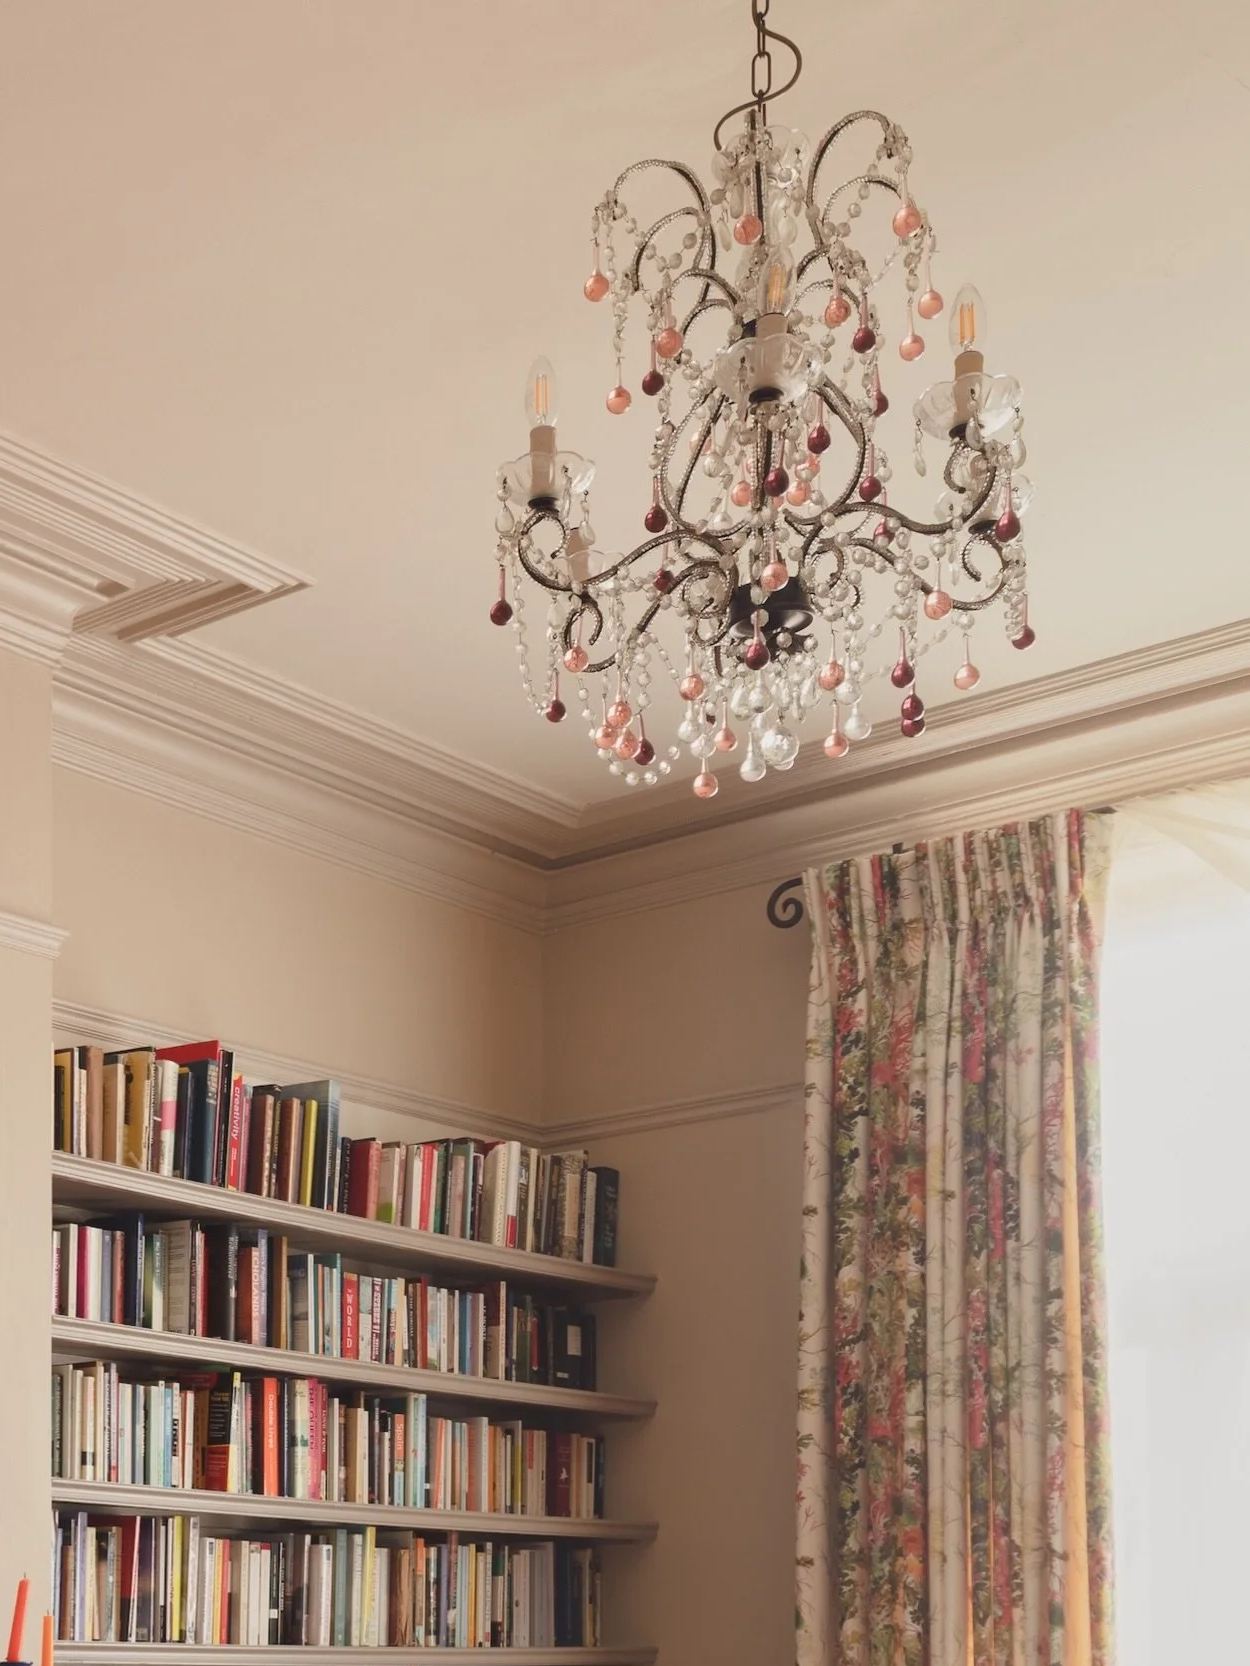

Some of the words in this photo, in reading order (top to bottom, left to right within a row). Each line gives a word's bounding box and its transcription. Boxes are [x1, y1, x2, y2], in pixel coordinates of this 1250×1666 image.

[232, 1086, 242, 1141] creativity
[252, 1251, 261, 1317] ECHOLANDS
[268, 1427, 276, 1449] Lives
[395, 1422, 405, 1451] Spain
